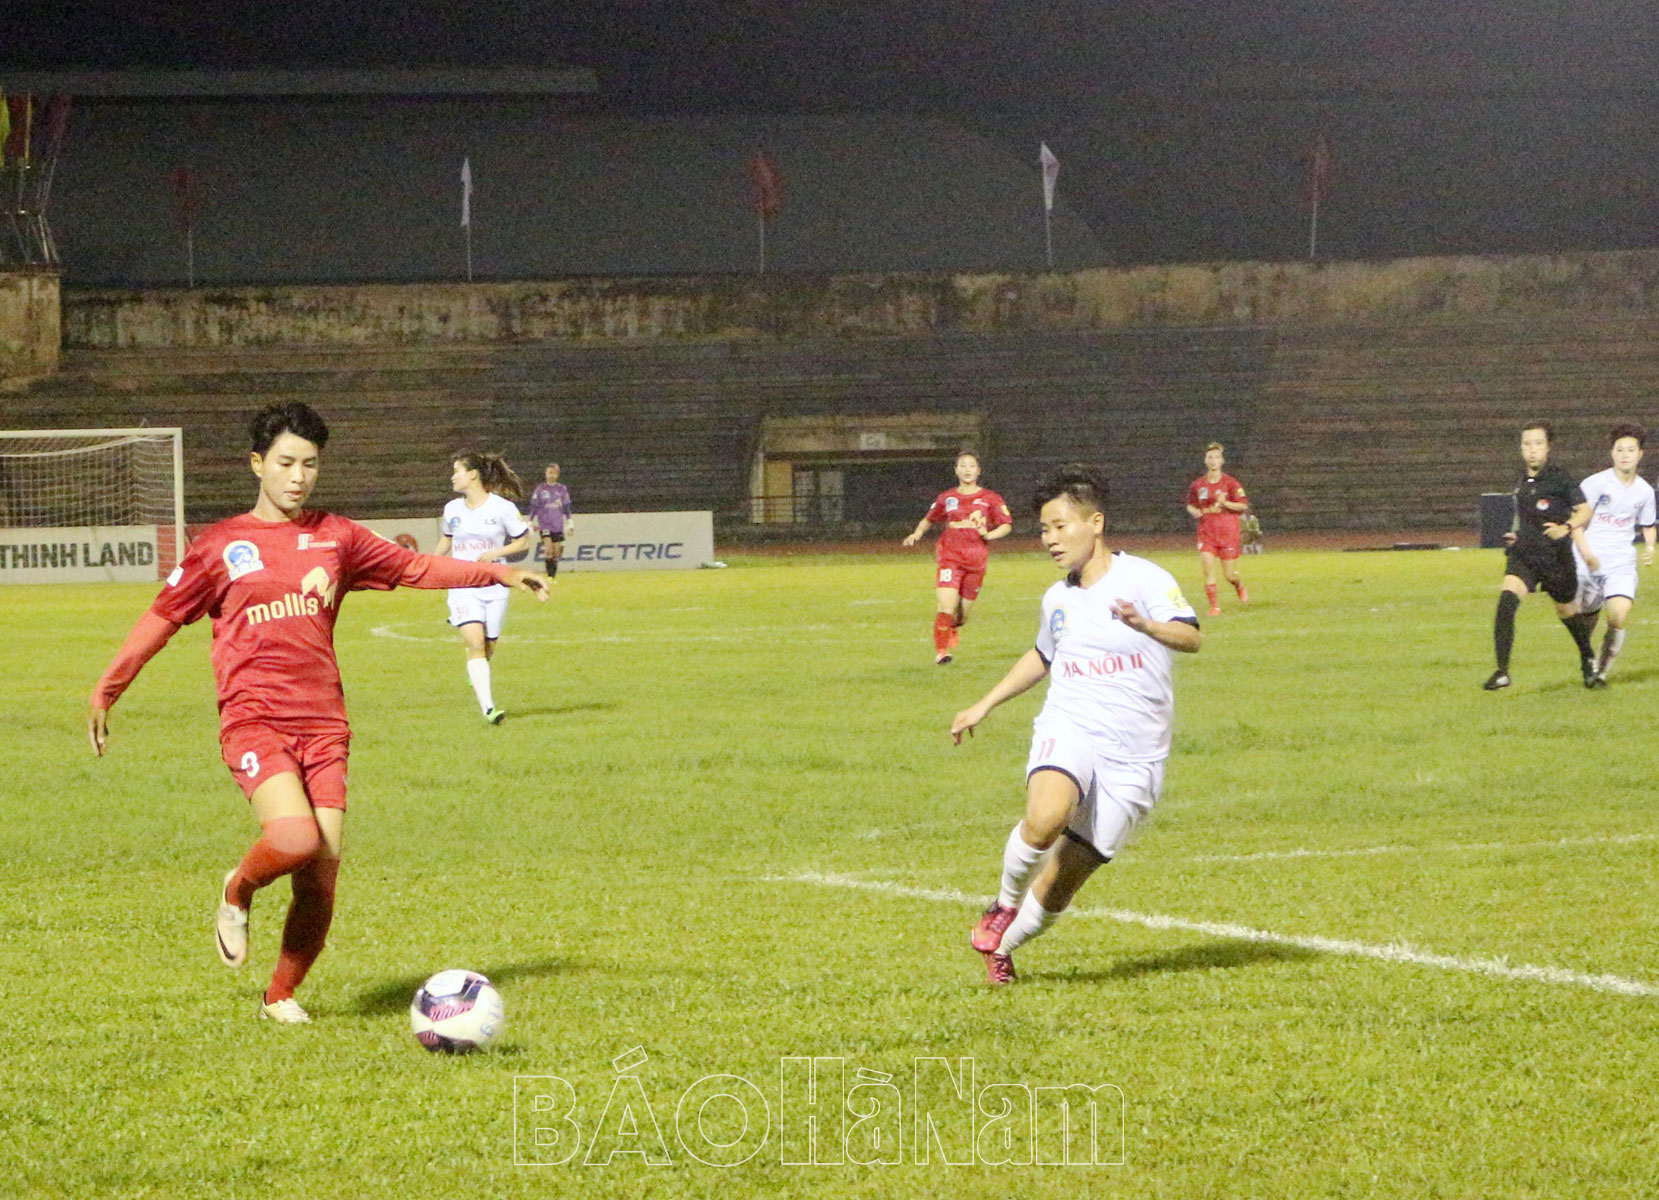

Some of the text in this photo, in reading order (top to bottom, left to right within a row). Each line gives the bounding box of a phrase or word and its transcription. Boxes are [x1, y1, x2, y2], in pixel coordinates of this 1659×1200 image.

[83, 541, 154, 568] LAND
[940, 568, 952, 583] 18
[246, 592, 319, 626] mollis
[241, 751, 260, 779] 3
